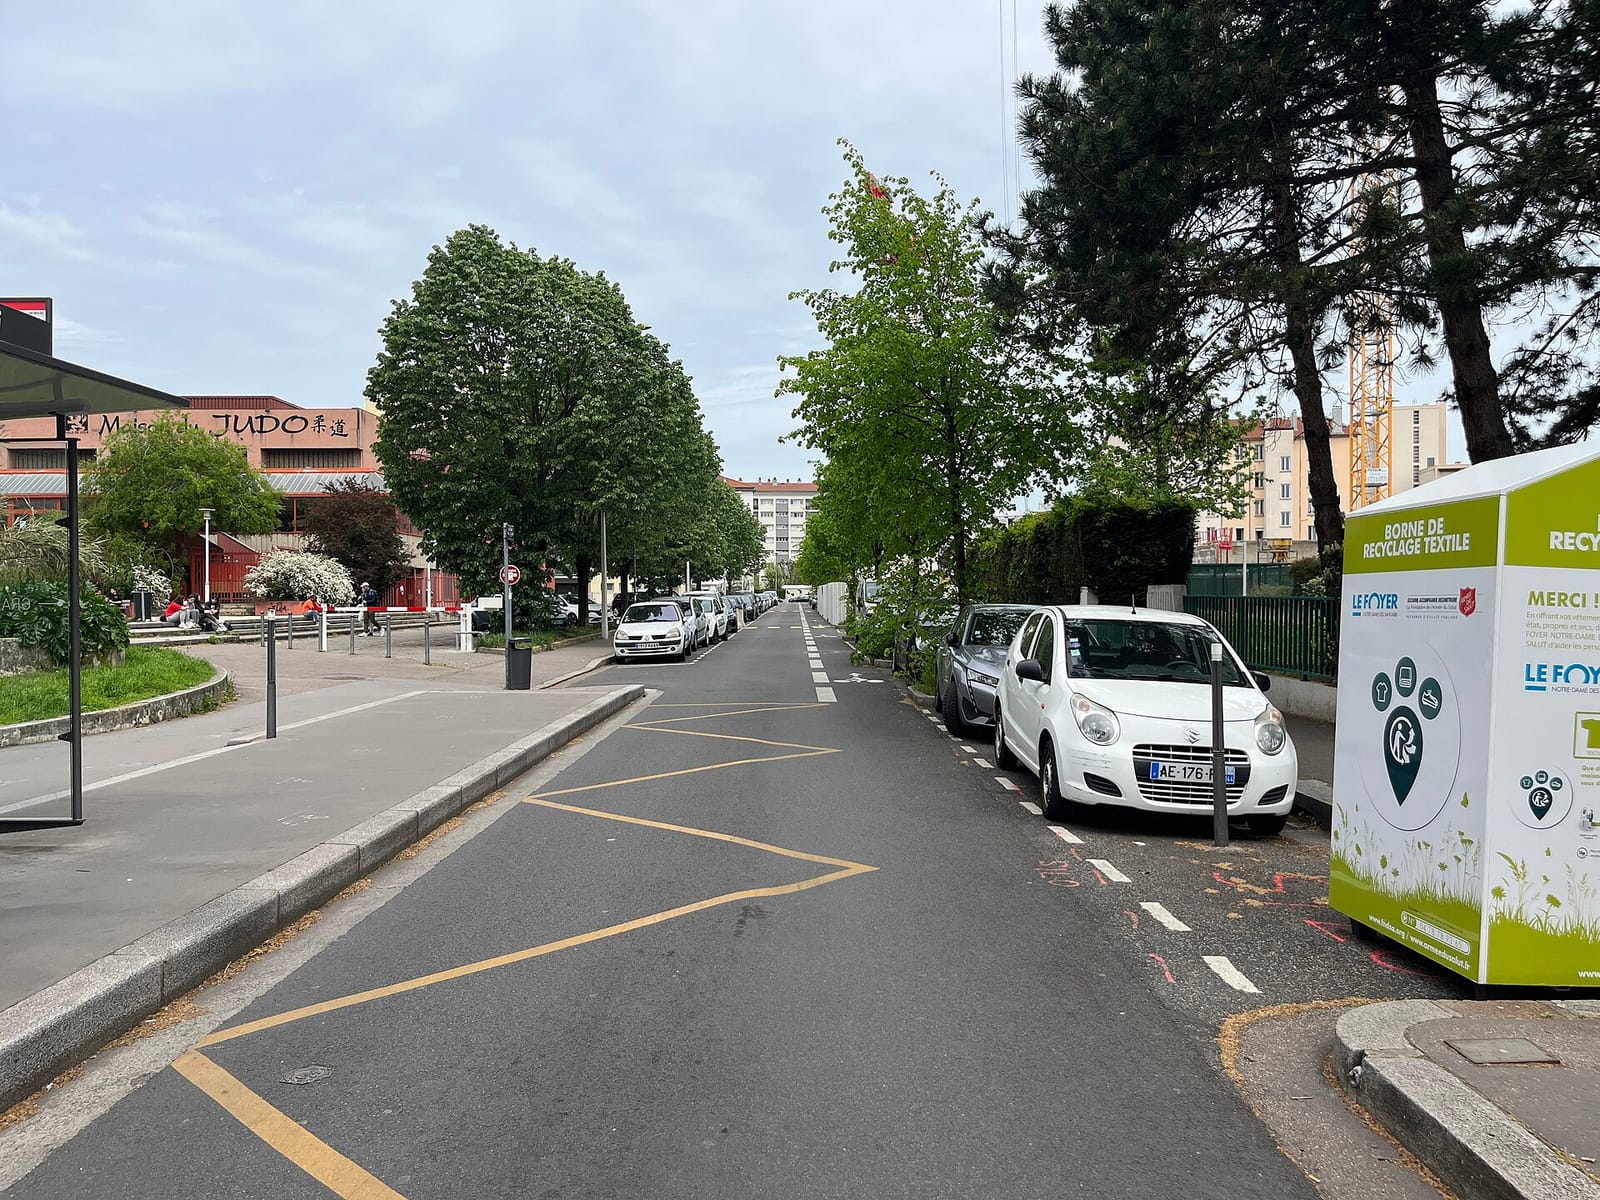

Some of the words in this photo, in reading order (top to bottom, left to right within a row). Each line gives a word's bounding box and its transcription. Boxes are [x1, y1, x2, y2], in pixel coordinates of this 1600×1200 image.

[209, 414, 309, 437] JUDO
[311, 414, 349, 437] 柔道
[1384, 520, 1424, 540] BORNE
[1427, 517, 1444, 535] DE
[1363, 538, 1421, 558] RECYCLAGE
[1424, 533, 1470, 553] TEXTILE
[1550, 531, 1600, 551] RECY
[1352, 594, 1362, 609] LE
[1363, 592, 1398, 609] FOYER
[1528, 591, 1587, 608] MERCI
[1536, 612, 1559, 620] offrant
[1525, 631, 1548, 639] FOYER
[1550, 632, 1596, 641] NOTRE-DAME
[1543, 623, 1569, 632] propres
[1524, 640, 1547, 648] SALUT
[1525, 663, 1548, 682] LE
[1551, 686, 1588, 694] NOTRE-DAME
